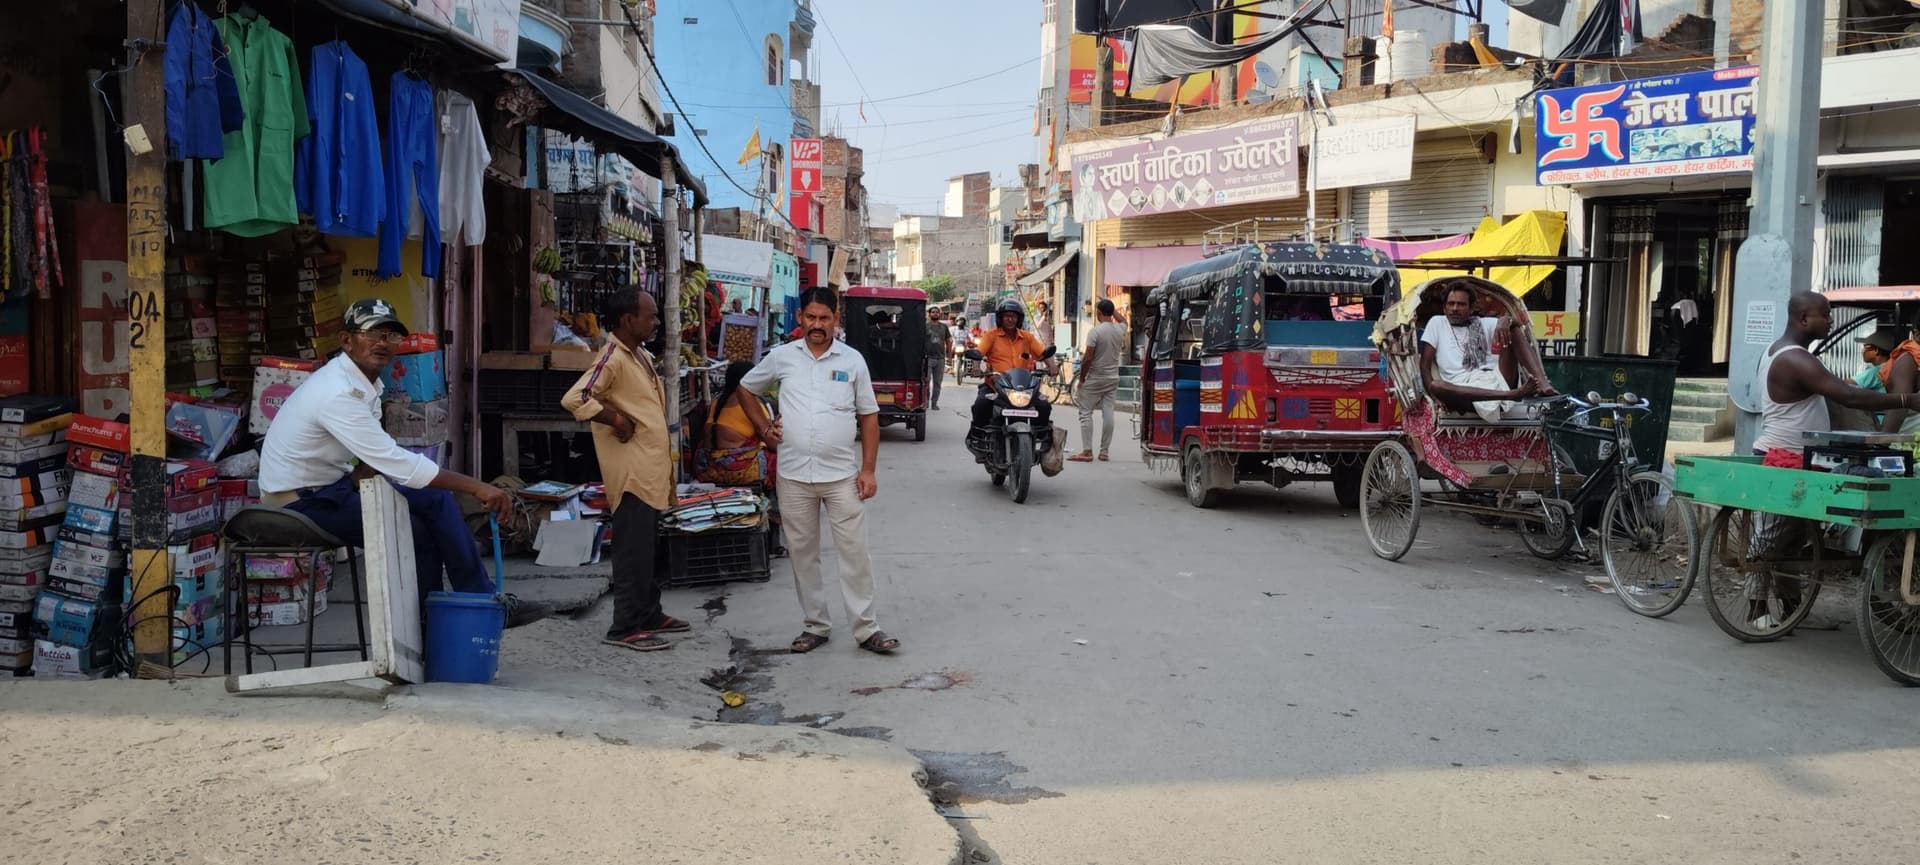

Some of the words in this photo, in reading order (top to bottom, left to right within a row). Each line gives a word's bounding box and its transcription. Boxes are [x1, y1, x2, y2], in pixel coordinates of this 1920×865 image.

[1623, 90, 1691, 126] जेन्स
[792, 141, 820, 159] VIP
[1099, 153, 1141, 190] स्वर्ण
[1144, 146, 1213, 183] वाटिका
[1217, 128, 1295, 174] ज्वेलर्स
[1615, 373, 1625, 382] 56
[72, 422, 113, 437] Bumchums
[38, 647, 72, 661] Hettich
